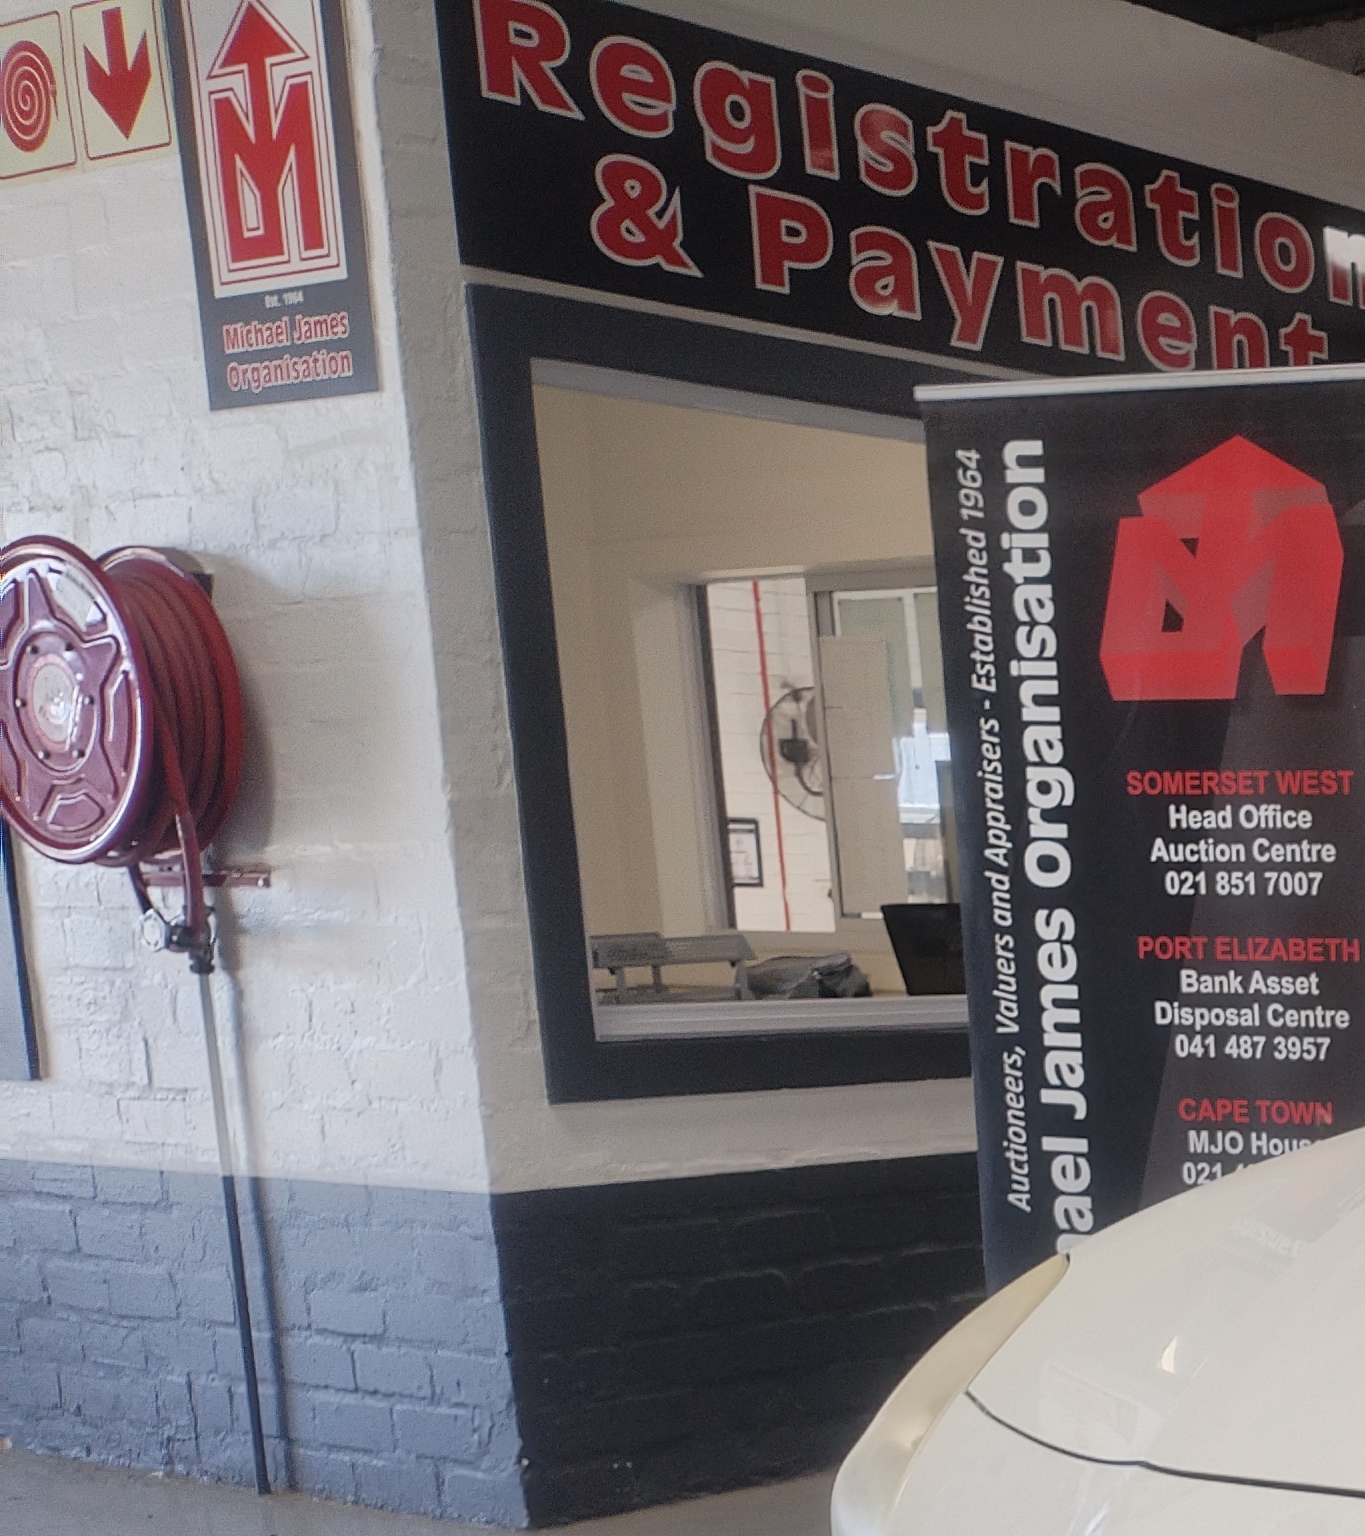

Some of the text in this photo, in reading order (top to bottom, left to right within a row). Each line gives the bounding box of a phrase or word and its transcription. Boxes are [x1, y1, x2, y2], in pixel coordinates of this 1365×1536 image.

[590, 153, 1328, 373] & Payment
[222, 311, 349, 354] Michael James
[227, 349, 353, 393] Organisation
[955, 448, 985, 520] 1964
[959, 527, 997, 693] Established
[1000, 440, 1076, 888] Organisation
[977, 718, 1013, 867] Appraisers
[1126, 770, 1355, 795] SOMERSET WEST
[1168, 804, 1313, 829] Head Office
[1150, 837, 1337, 862] Auction Centre
[984, 872, 1013, 928] and
[1165, 871, 1323, 896] 021 851 7007
[1137, 935, 1361, 963] PORT ELIZABETH
[991, 934, 1020, 1034] Valuers
[1180, 968, 1320, 995] Bank Asset
[1033, 907, 1088, 1120] James
[1154, 1001, 1351, 1031] Disposal Centre
[1174, 1034, 1331, 1061] 041 487 3957
[1001, 1046, 1031, 1213] Auctioneers,
[1178, 1098, 1333, 1126] CAPE TOWN
[1188, 1129, 1244, 1154] MJO
[1182, 1161, 1223, 1185] 021
